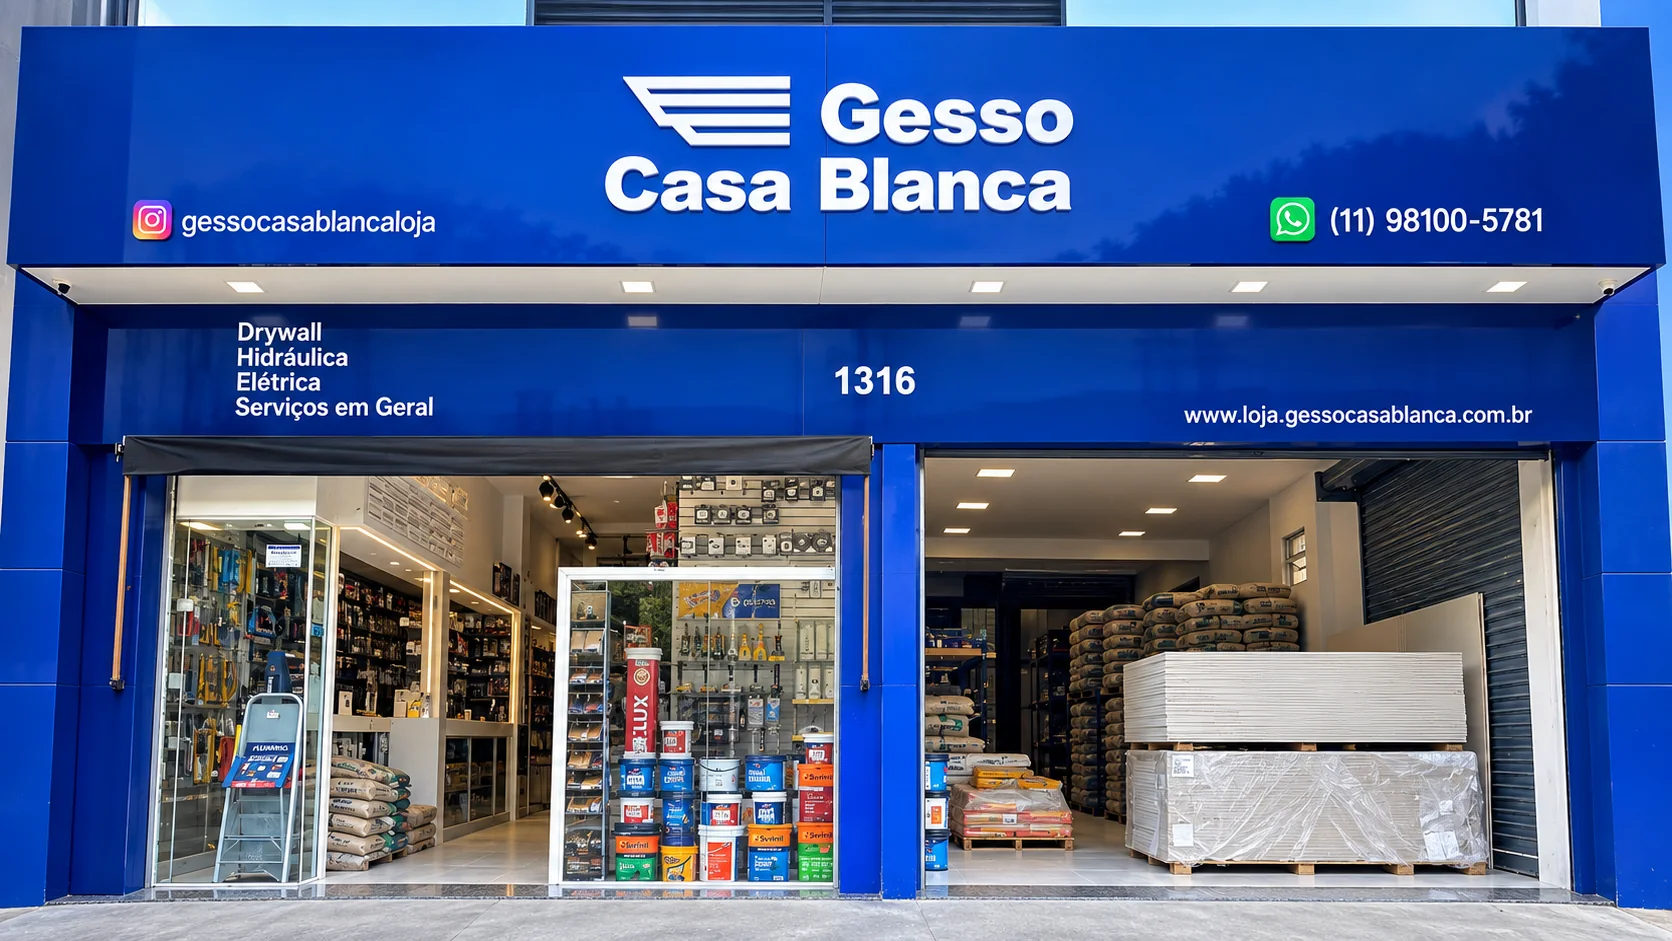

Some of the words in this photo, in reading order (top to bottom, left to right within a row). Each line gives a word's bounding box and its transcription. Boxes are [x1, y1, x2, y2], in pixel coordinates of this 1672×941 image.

[820, 83, 1074, 145] Gesso
[605, 155, 791, 213] Casa
[820, 156, 1073, 213] Blanca
[181, 209, 436, 239] gessocasablancaloja
[1330, 206, 1375, 237] (11)
[1385, 207, 1543, 234] 98100-5781
[238, 321, 322, 346] Drywall
[237, 344, 348, 367] Hidráulica
[237, 371, 321, 391] Elétrica
[835, 366, 916, 395] 1316
[235, 397, 329, 421] Serviços
[335, 401, 369, 416] em
[375, 396, 434, 417] Geral
[1184, 404, 1533, 428] www.loja.gessocasablanca.com.br
